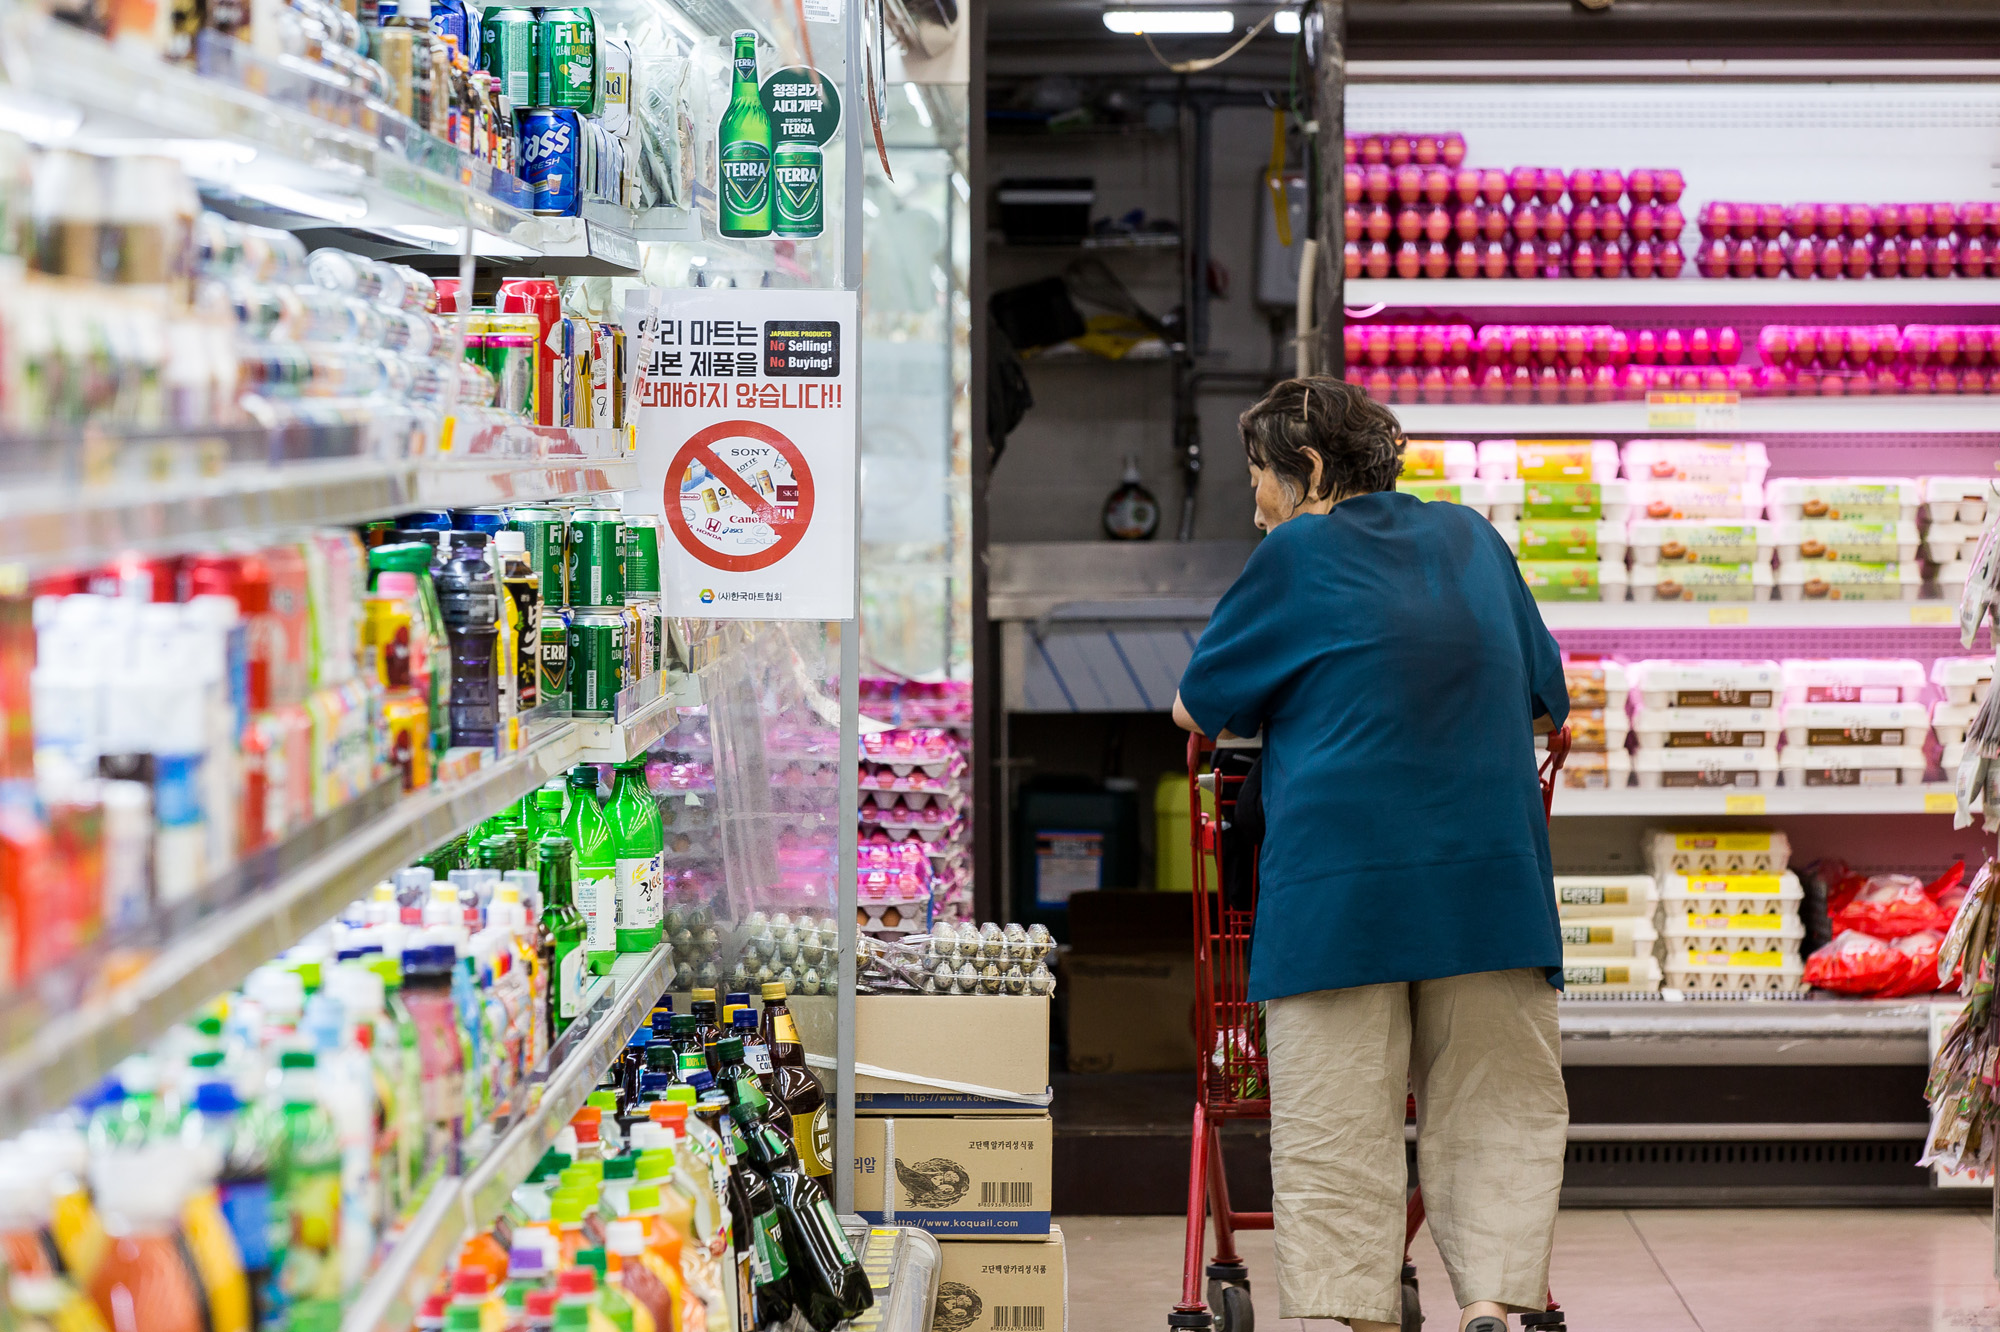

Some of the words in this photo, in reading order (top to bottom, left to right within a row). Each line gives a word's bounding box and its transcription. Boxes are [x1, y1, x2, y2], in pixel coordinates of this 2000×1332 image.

[555, 45, 570, 56] CLEAN
[571, 44, 591, 56] BARLEY
[734, 58, 755, 68] TERRA
[772, 83, 823, 97] 청정라거
[780, 123, 816, 135] TERRA
[723, 162, 767, 178] TERRA
[776, 167, 819, 184] TERRA
[690, 320, 758, 346] 마트는
[769, 340, 786, 351] No
[788, 339, 832, 354] Selling!
[689, 351, 758, 377] 제품을
[769, 356, 786, 368] No
[788, 356, 833, 371] Buying!
[641, 381, 728, 408] 판매하지
[735, 382, 842, 409] 않습니다!!
[731, 448, 770, 457] SONY
[736, 457, 758, 473] LOTTE
[695, 527, 723, 542] HONDA
[717, 591, 782, 602] (사)한국마트협회
[686, 1057, 700, 1067] 100%
[968, 1140, 990, 1150] 고단백
[981, 1264, 1002, 1275] 고단백
